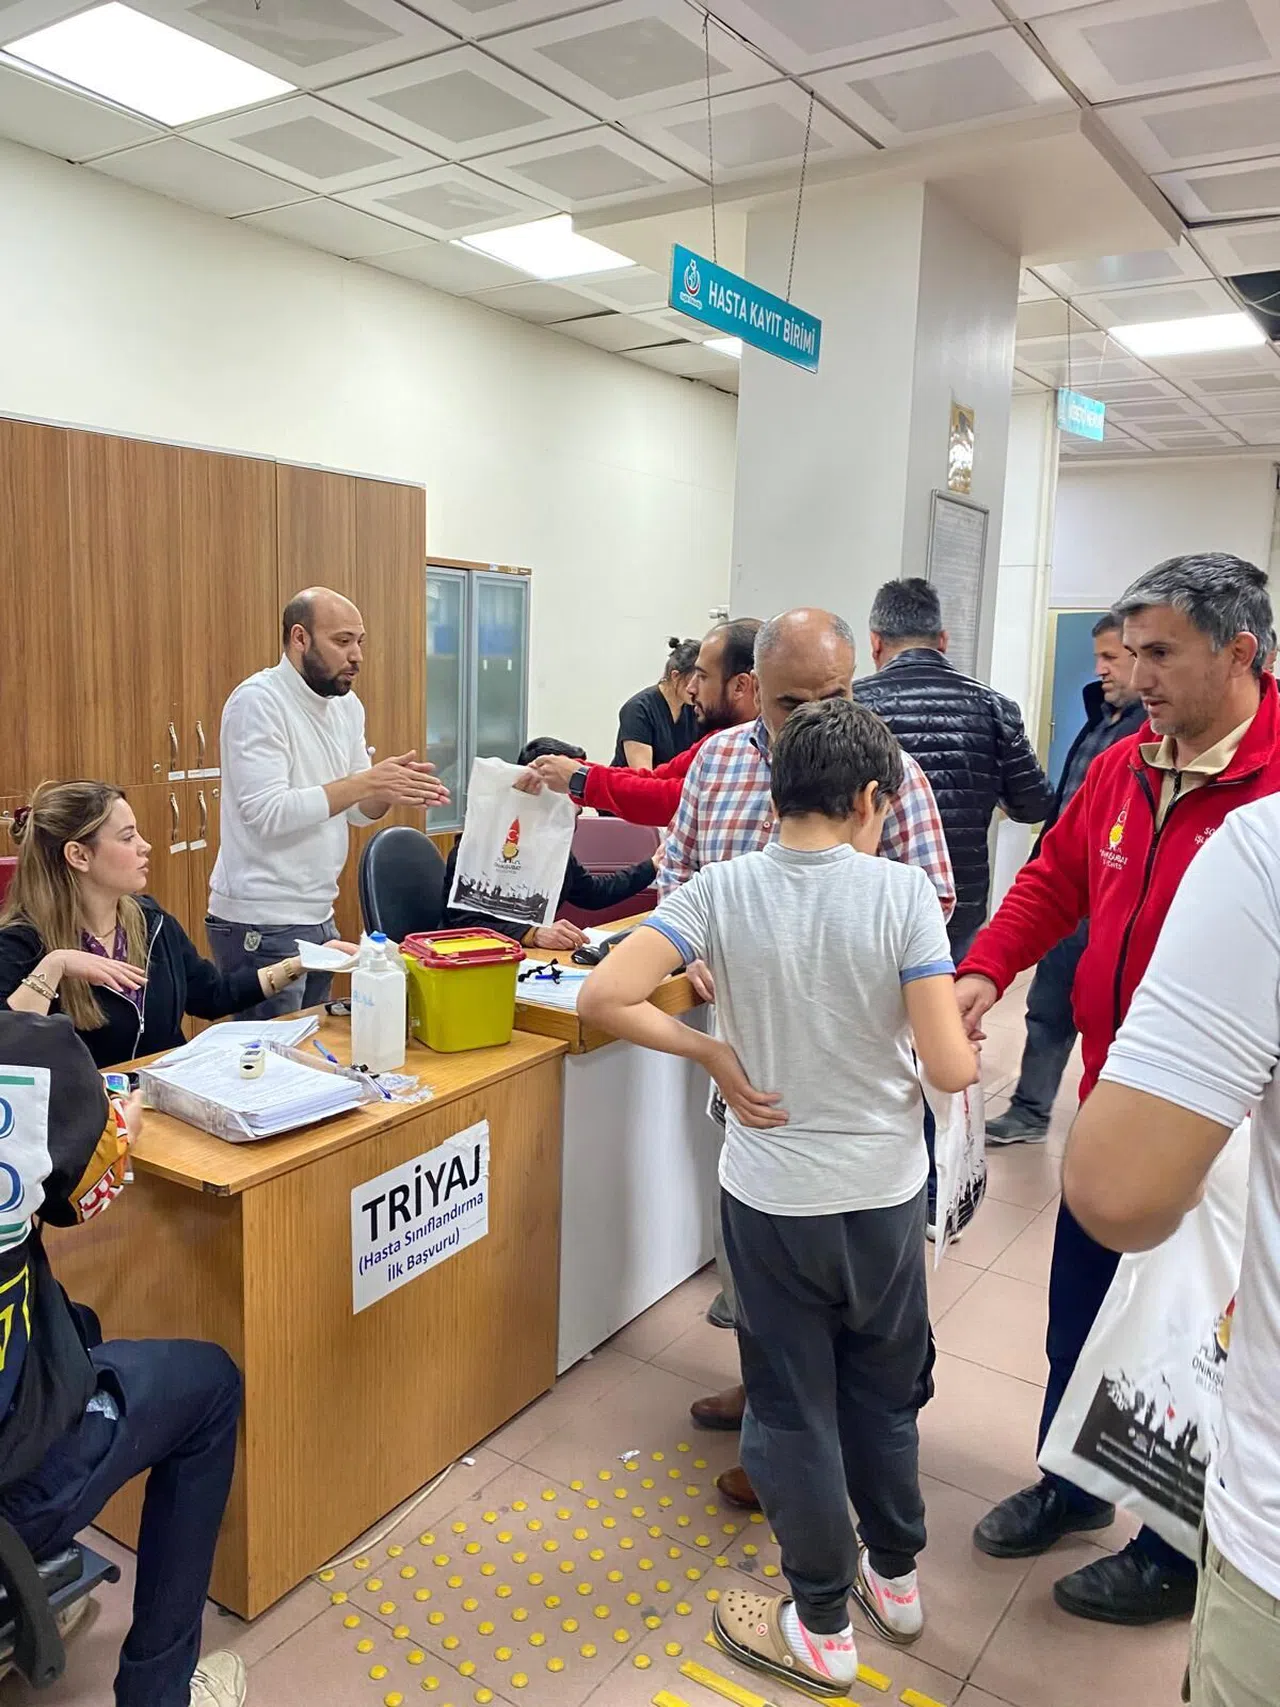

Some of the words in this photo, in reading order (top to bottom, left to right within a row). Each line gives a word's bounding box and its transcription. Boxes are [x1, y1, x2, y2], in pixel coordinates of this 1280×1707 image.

[708, 280, 747, 323] HASTA
[749, 301, 782, 338] KAYIT
[783, 316, 816, 356] BİRİMİ
[361, 1144, 481, 1242] TRİYAJ
[359, 1239, 401, 1276] (Hasta
[404, 1192, 483, 1247] Sınıflandırma
[387, 1263, 404, 1283] İlk
[407, 1227, 460, 1271] Başvuru)
